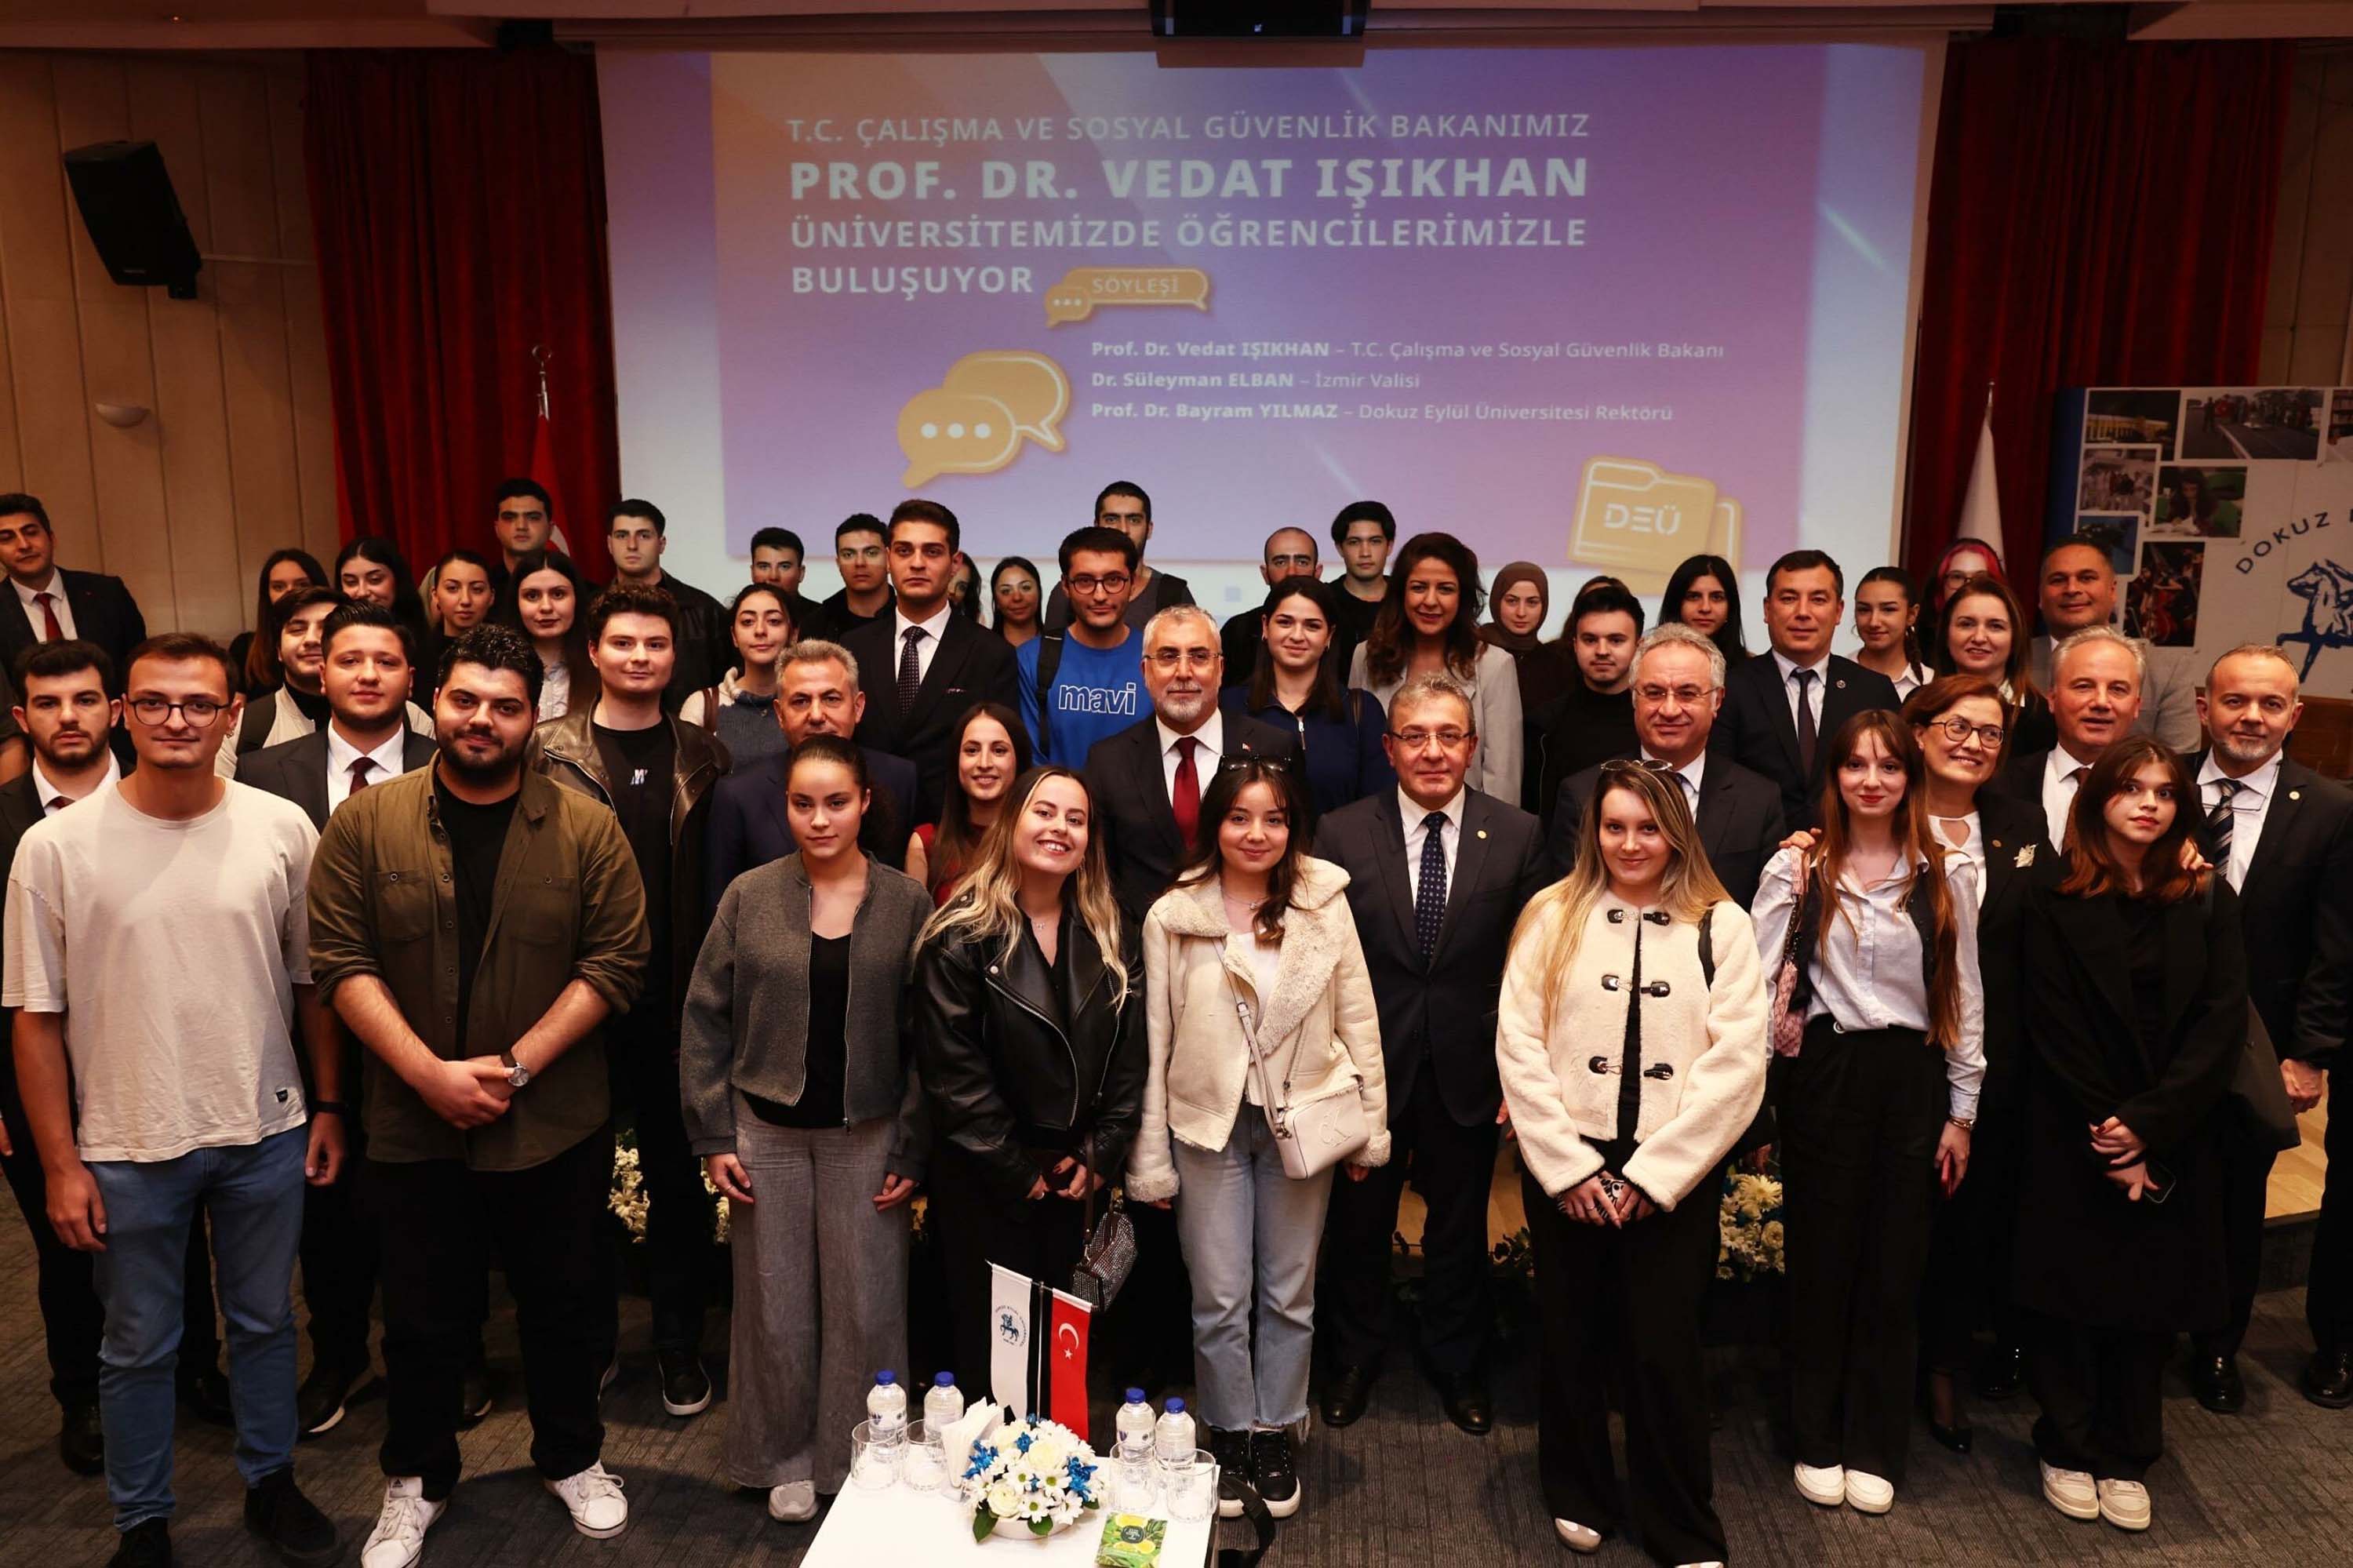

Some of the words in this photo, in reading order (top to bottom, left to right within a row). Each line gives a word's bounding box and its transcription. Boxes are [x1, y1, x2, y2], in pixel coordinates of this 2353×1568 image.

[787, 120, 842, 141] T.C.
[857, 118, 1004, 147] ÇALIŞMA
[1016, 118, 1053, 140] VE
[1067, 116, 1191, 140] SOSYAL
[1205, 111, 1377, 139] GÜVENLİK
[1391, 114, 1589, 138] BAKANIMIZ
[791, 161, 956, 199] PROF.
[982, 160, 1078, 198] DR.
[1102, 158, 1293, 198] VEDAT
[1316, 158, 1587, 209] IŞIKHAN
[791, 213, 1160, 249] ÜNİVERSİTEMİZDE
[1178, 213, 1586, 247] ÖĞRENCİLERİMİZLE
[792, 266, 1034, 301] BULUŞUYOR
[1093, 275, 1180, 297] SÖYLEŞİ
[1092, 342, 1138, 357] Prof.
[1145, 343, 1170, 357] Dr.
[1177, 342, 1236, 357] Vedat
[1242, 343, 1329, 360] IŞIKHAN
[1351, 343, 1383, 358] T.C.
[1390, 343, 1464, 360] Çalışma
[1471, 346, 1492, 358] ve
[1499, 343, 1559, 362] Sosyal
[1566, 343, 1650, 358] Güvenlik
[1658, 343, 1724, 358] Bakanı
[1092, 373, 1118, 387] Dr.
[1124, 373, 1222, 391] Süleyman
[1229, 373, 1293, 387] ELBAN
[1315, 372, 1365, 387] İzmir
[1370, 373, 1420, 388] Valisi
[1092, 403, 1138, 418] Prof.
[1144, 403, 1170, 418] Dr.
[1177, 403, 1253, 421] Bayram
[1260, 403, 1337, 418] YILMAZ
[1359, 403, 1418, 419] Dokuz
[1425, 404, 1468, 423] Eylül
[1476, 402, 1589, 420] Üniversitesi
[1595, 404, 1673, 421] Rektörü
[1604, 503, 1681, 536] DEÜ
[2236, 511, 2330, 573] DOKUZ
[1059, 682, 1136, 715] mavi
